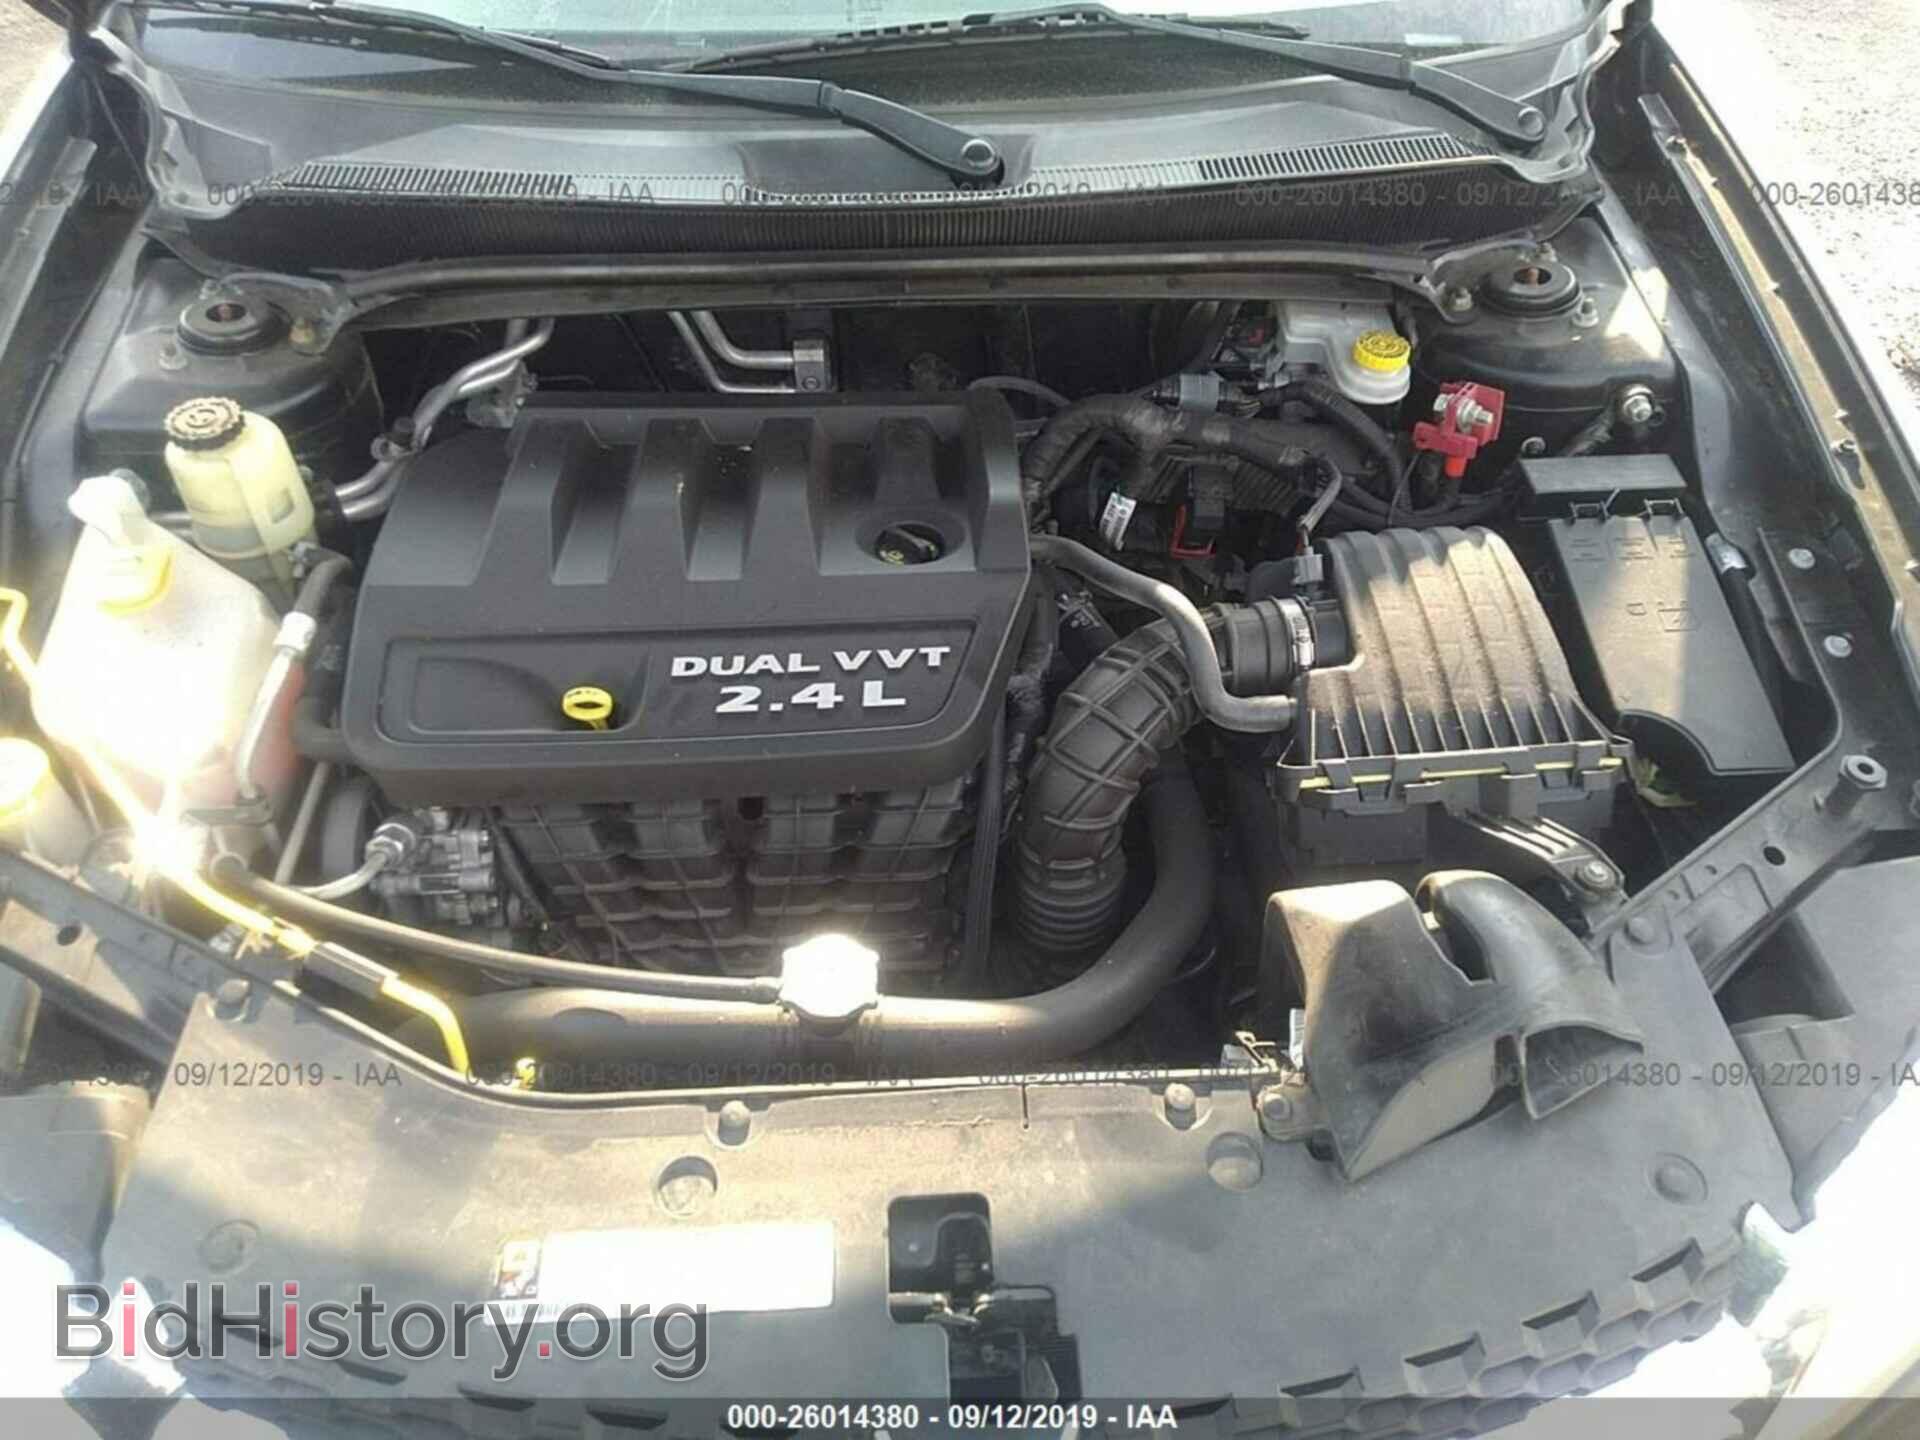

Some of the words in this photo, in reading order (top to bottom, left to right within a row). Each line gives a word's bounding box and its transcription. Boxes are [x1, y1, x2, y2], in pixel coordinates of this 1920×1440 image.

[671, 653, 821, 677] DUAL
[833, 646, 950, 671] VVT
[715, 682, 844, 713] 2.4
[862, 680, 906, 707] L
